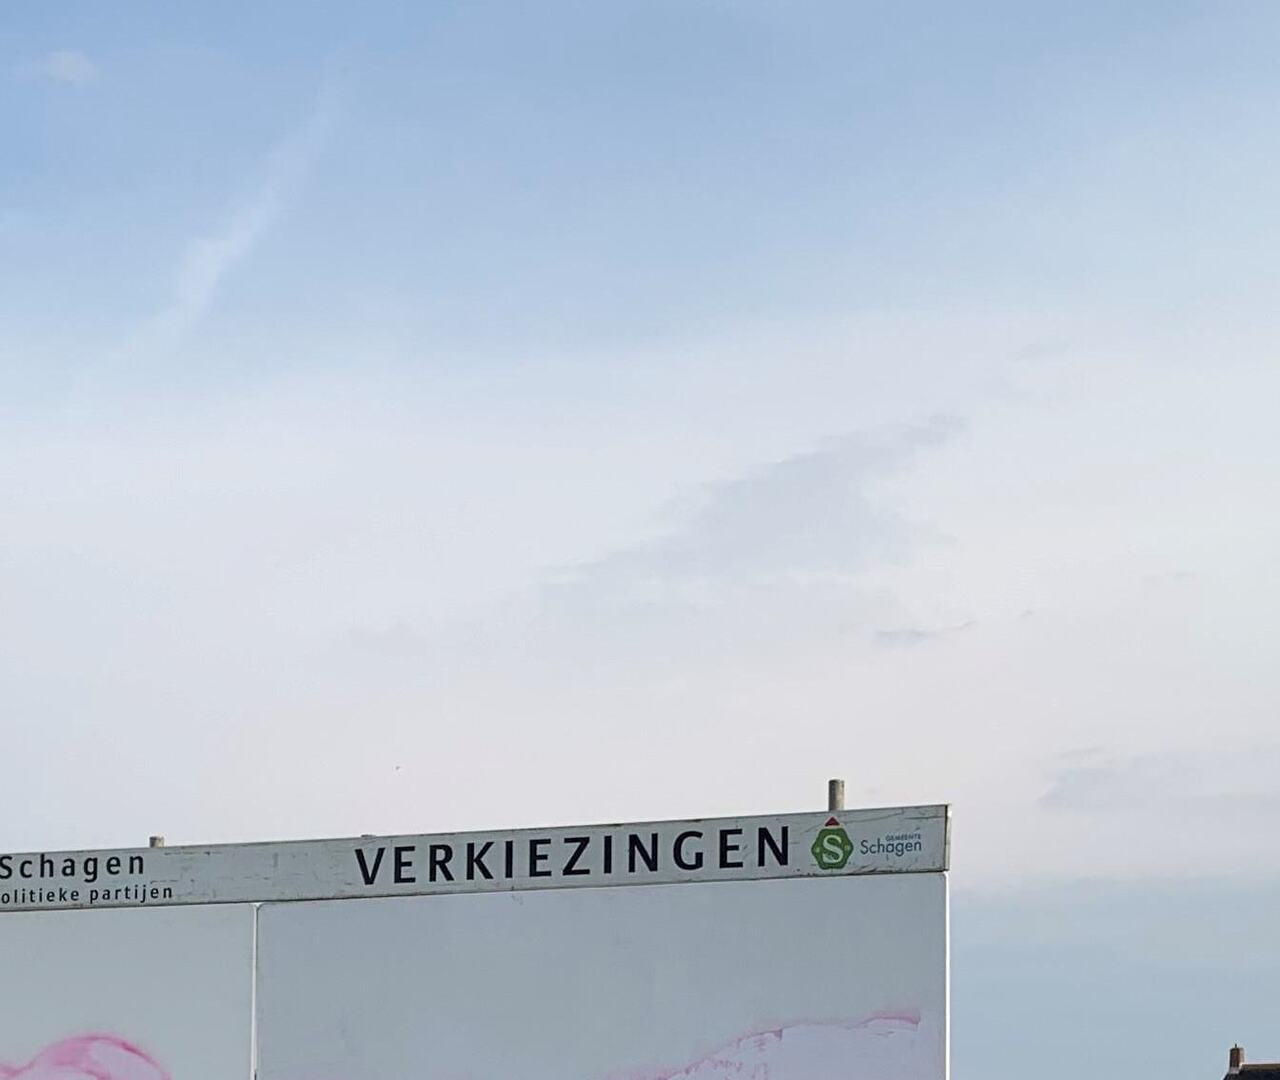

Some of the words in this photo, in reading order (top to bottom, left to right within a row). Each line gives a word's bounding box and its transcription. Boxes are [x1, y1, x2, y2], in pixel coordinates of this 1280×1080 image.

[354, 825, 790, 886] VERKIEZINGEN
[860, 838, 922, 857] Schagen
[89, 884, 173, 904] partijen
